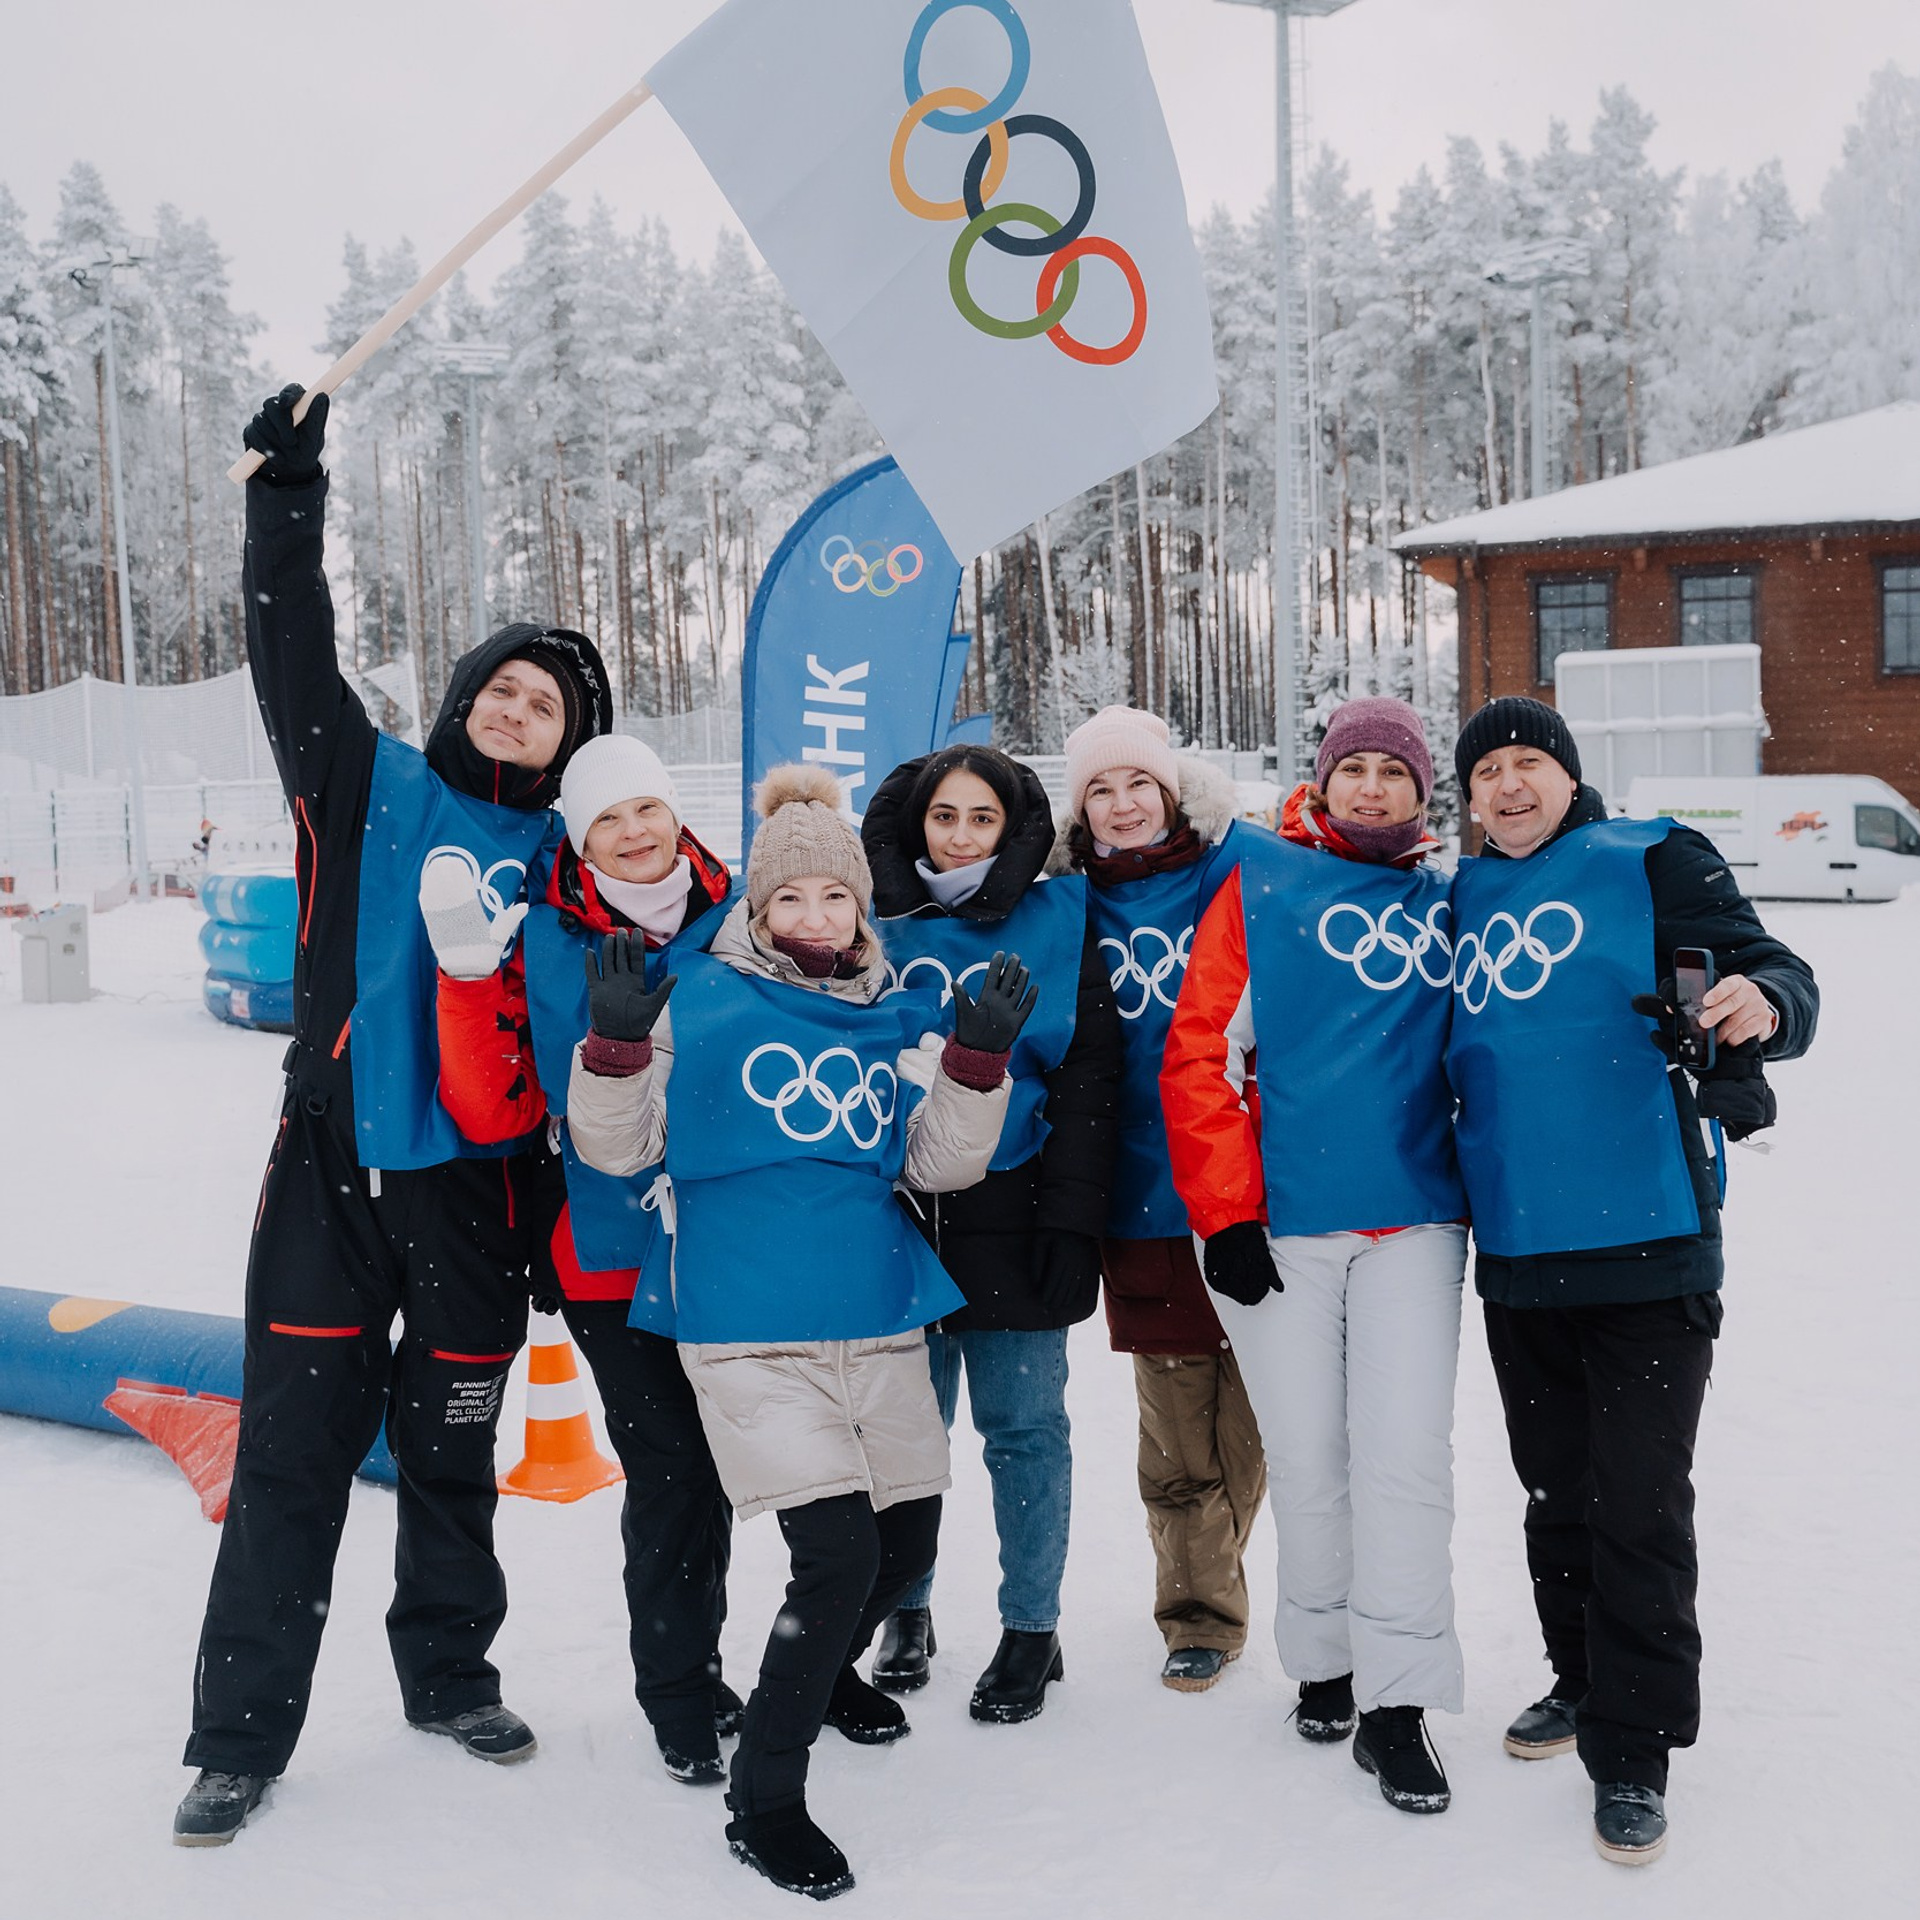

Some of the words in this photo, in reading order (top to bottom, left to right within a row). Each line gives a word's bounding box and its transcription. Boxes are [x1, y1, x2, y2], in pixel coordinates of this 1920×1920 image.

[447, 1399, 484, 1407] ORIGINAL
[446, 1408, 463, 1416] SPCL
[445, 1416, 473, 1424] PLANET
